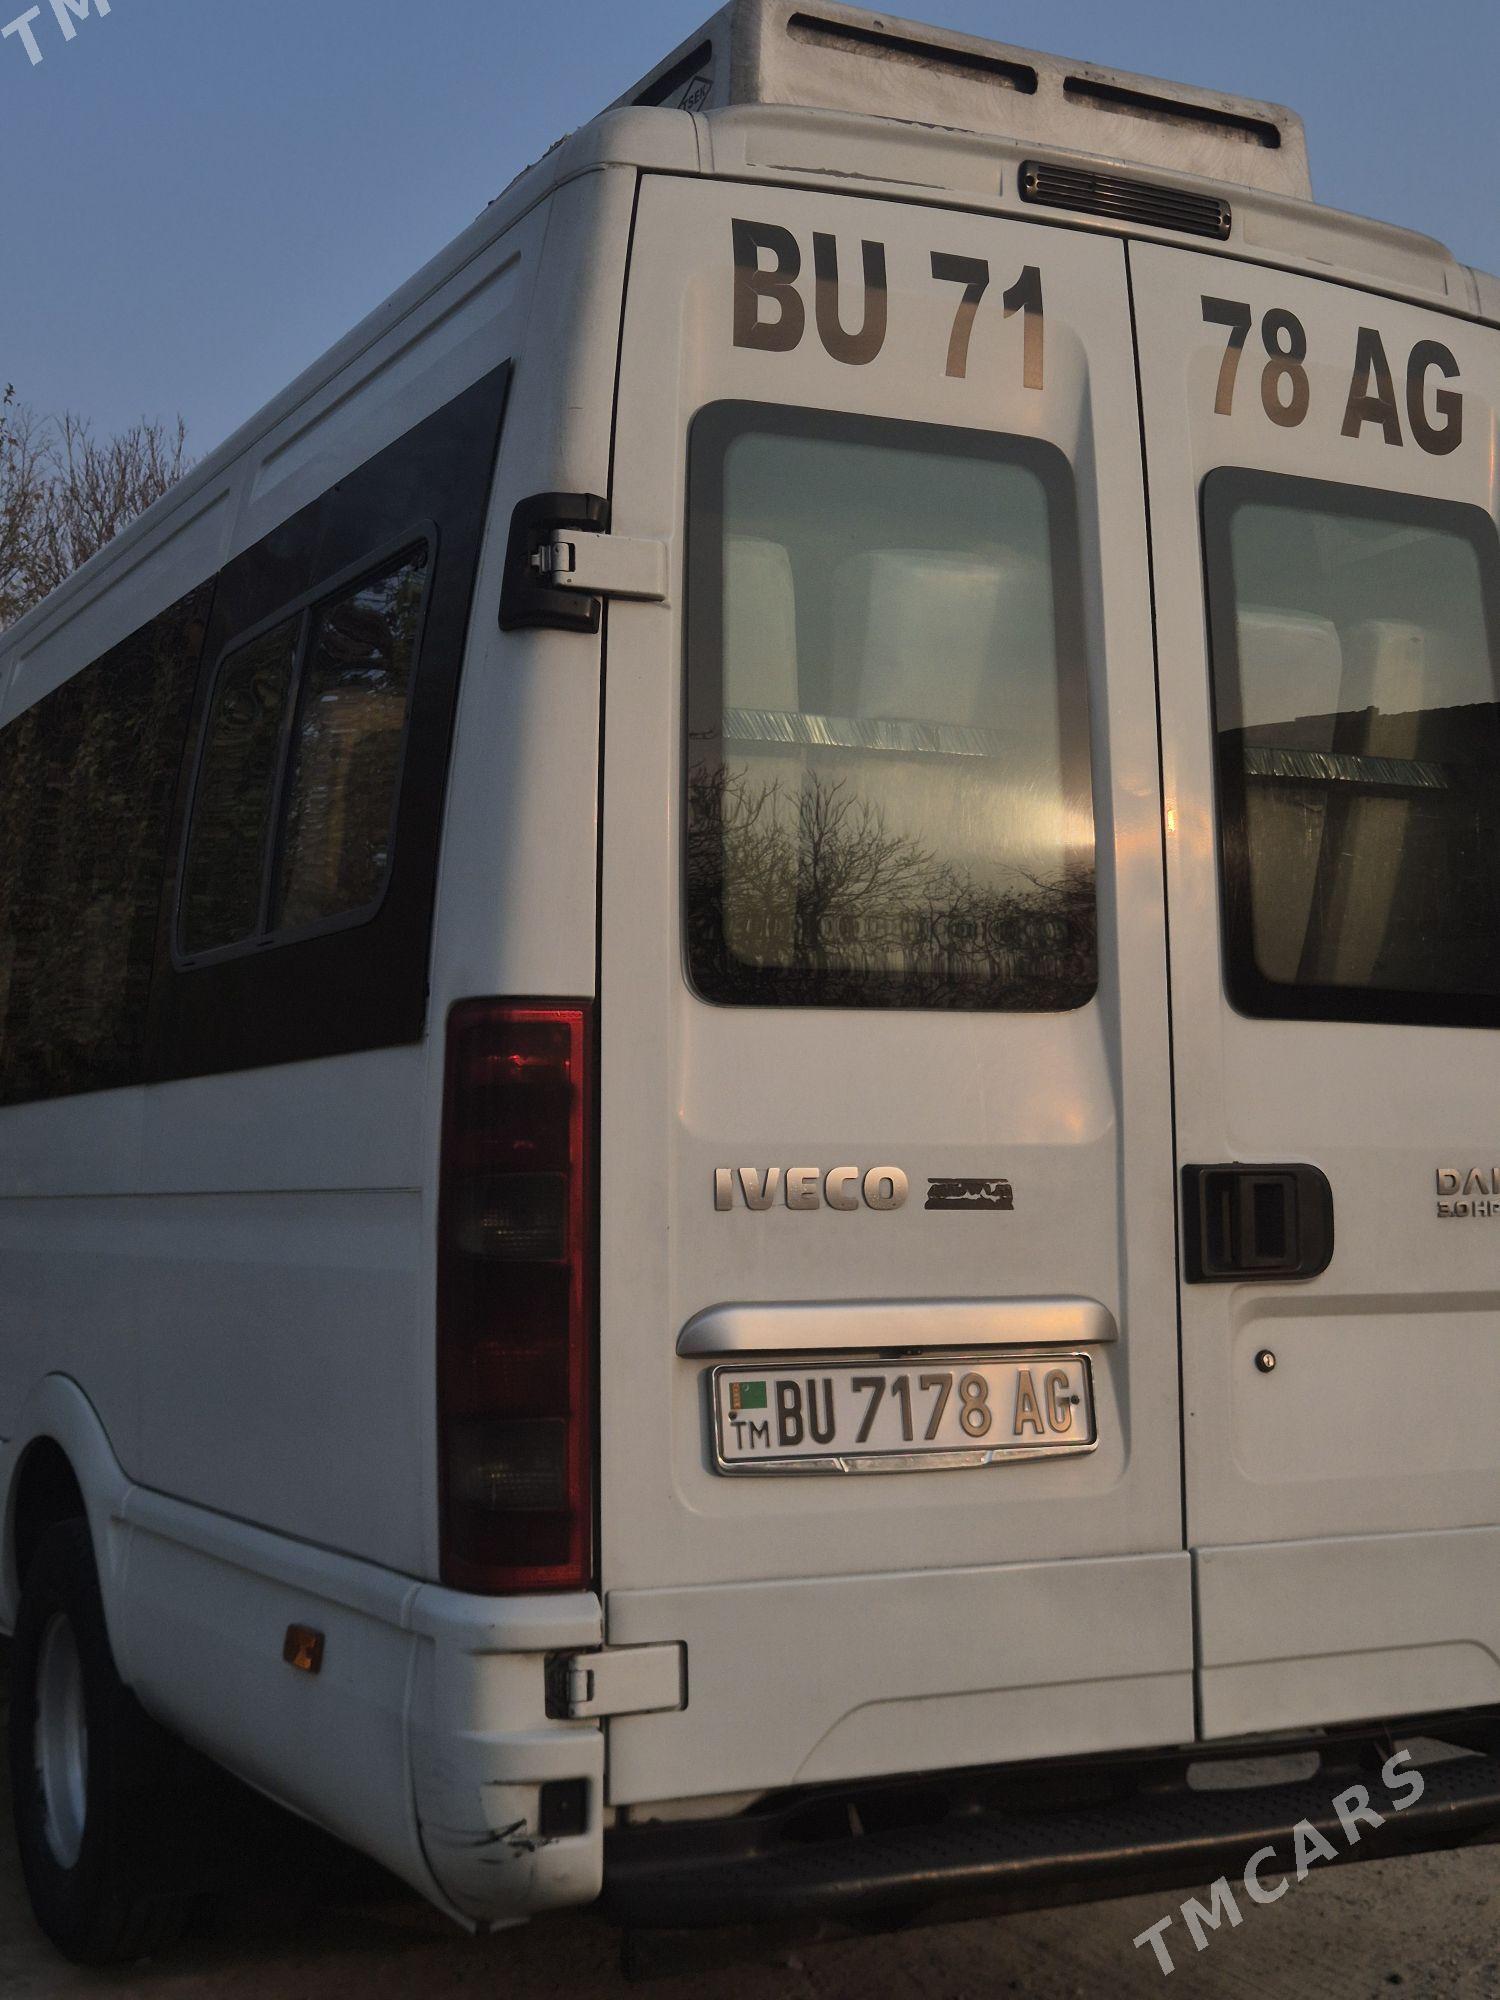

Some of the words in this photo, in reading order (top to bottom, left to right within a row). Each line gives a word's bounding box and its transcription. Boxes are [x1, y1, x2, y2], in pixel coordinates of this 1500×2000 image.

[732, 217, 888, 366] BU
[930, 250, 1044, 390] 71
[1200, 295, 1310, 427] 78
[1340, 326, 1463, 456] AG
[713, 1166, 909, 1211] IVECO
[729, 1420, 772, 1450] TM
[775, 1378, 836, 1447] BU
[851, 1371, 992, 1443] 7178
[1012, 1368, 1073, 1435] AG
